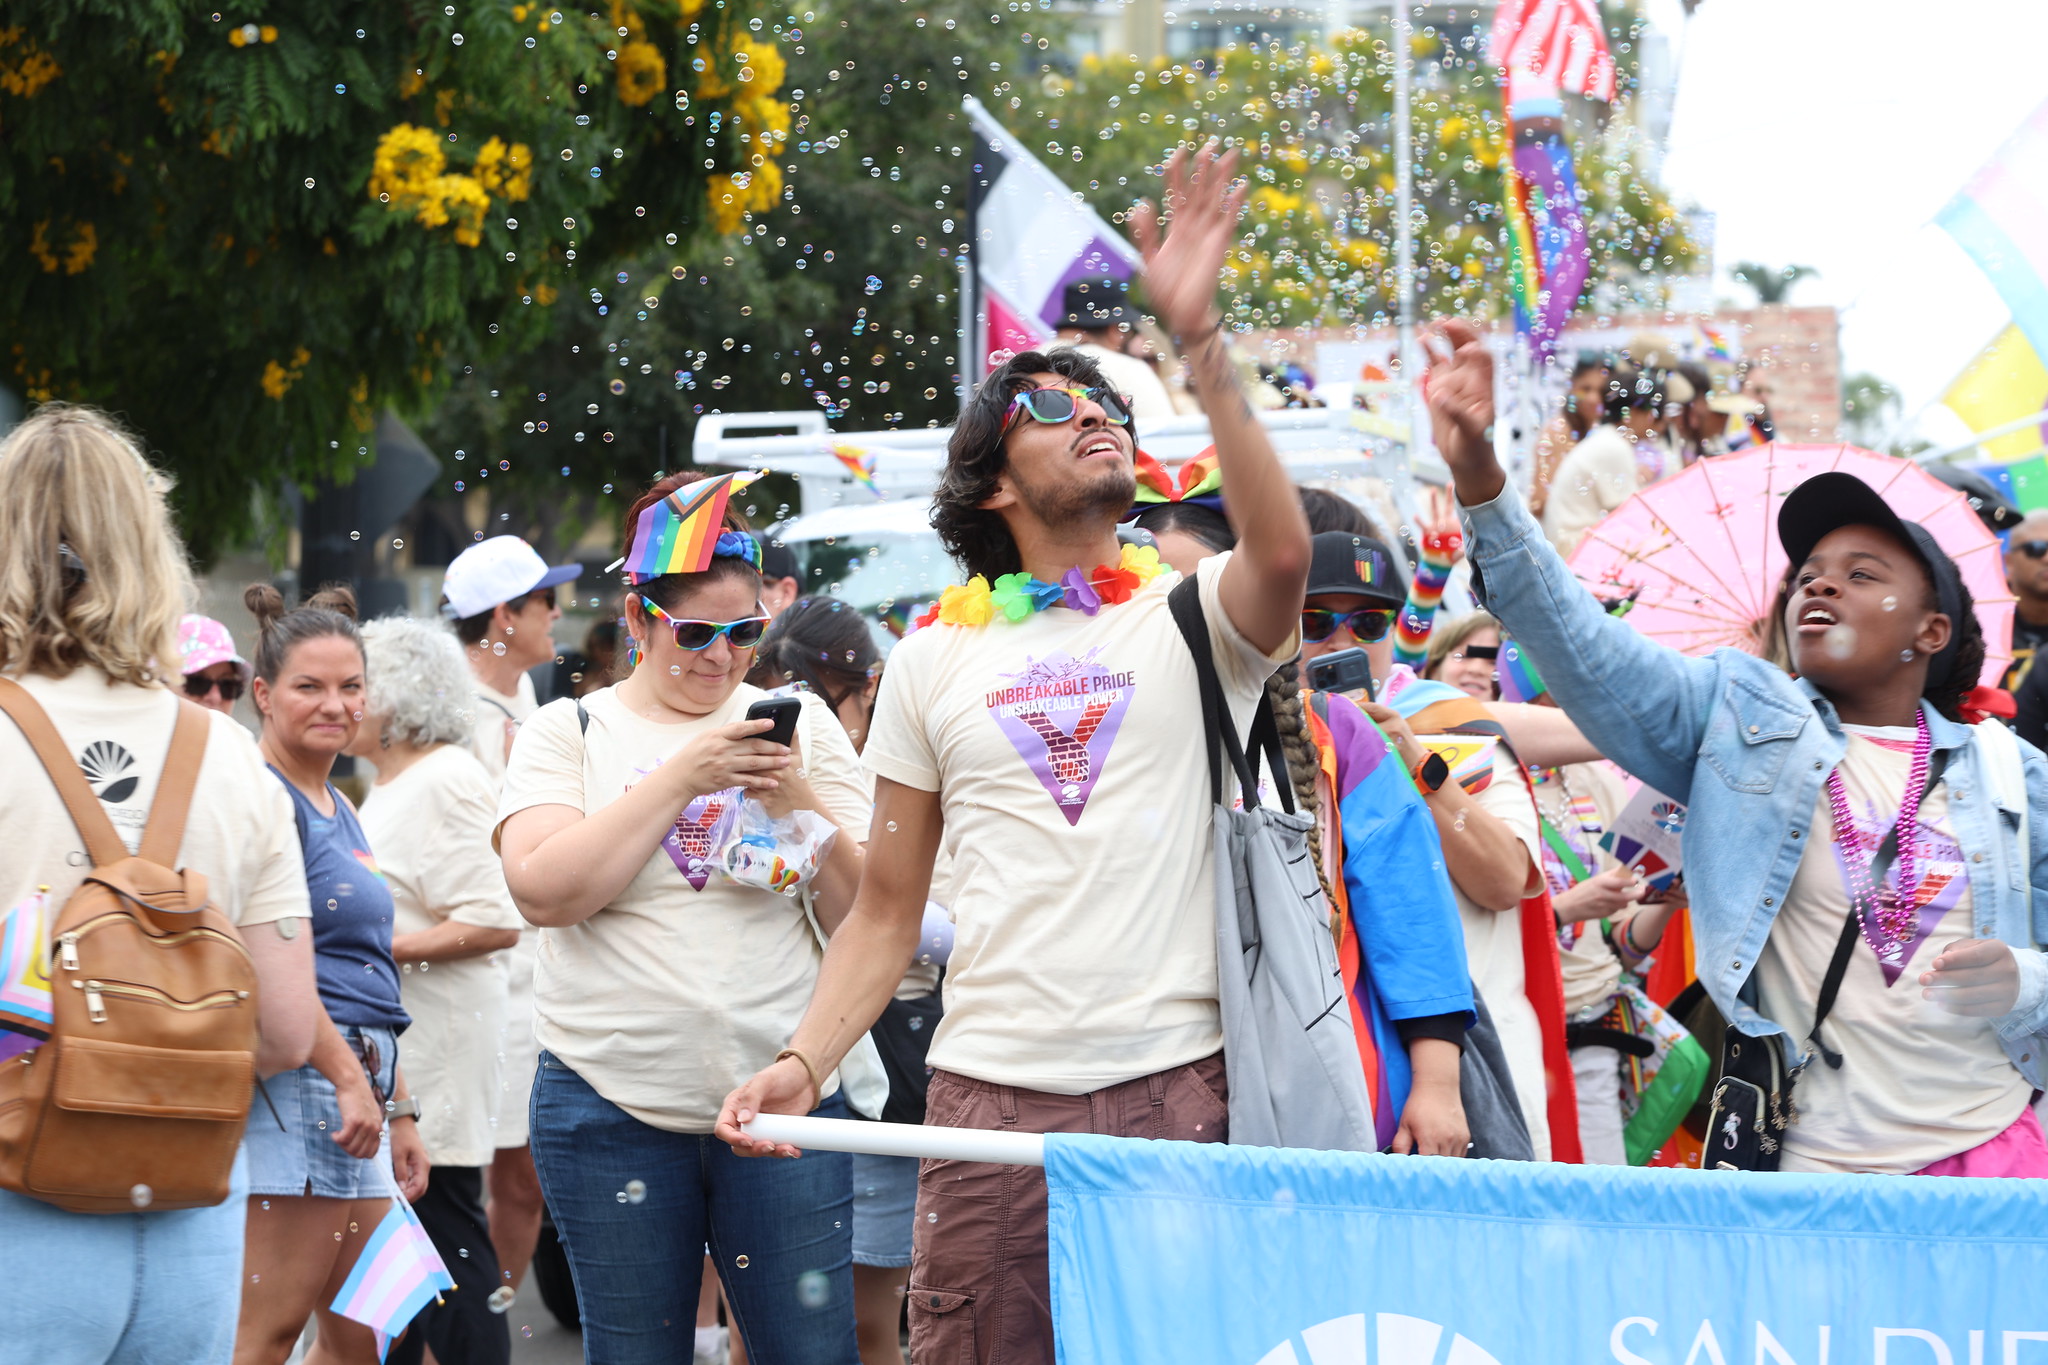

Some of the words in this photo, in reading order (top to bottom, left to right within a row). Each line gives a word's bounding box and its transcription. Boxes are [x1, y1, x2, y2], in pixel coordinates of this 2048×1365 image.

[986, 677, 1090, 708] UNBREAKABLE
[1093, 670, 1136, 692] PRIDE
[1000, 694, 1081, 719] UNSHAKEABLE
[1083, 689, 1124, 706] POWER
